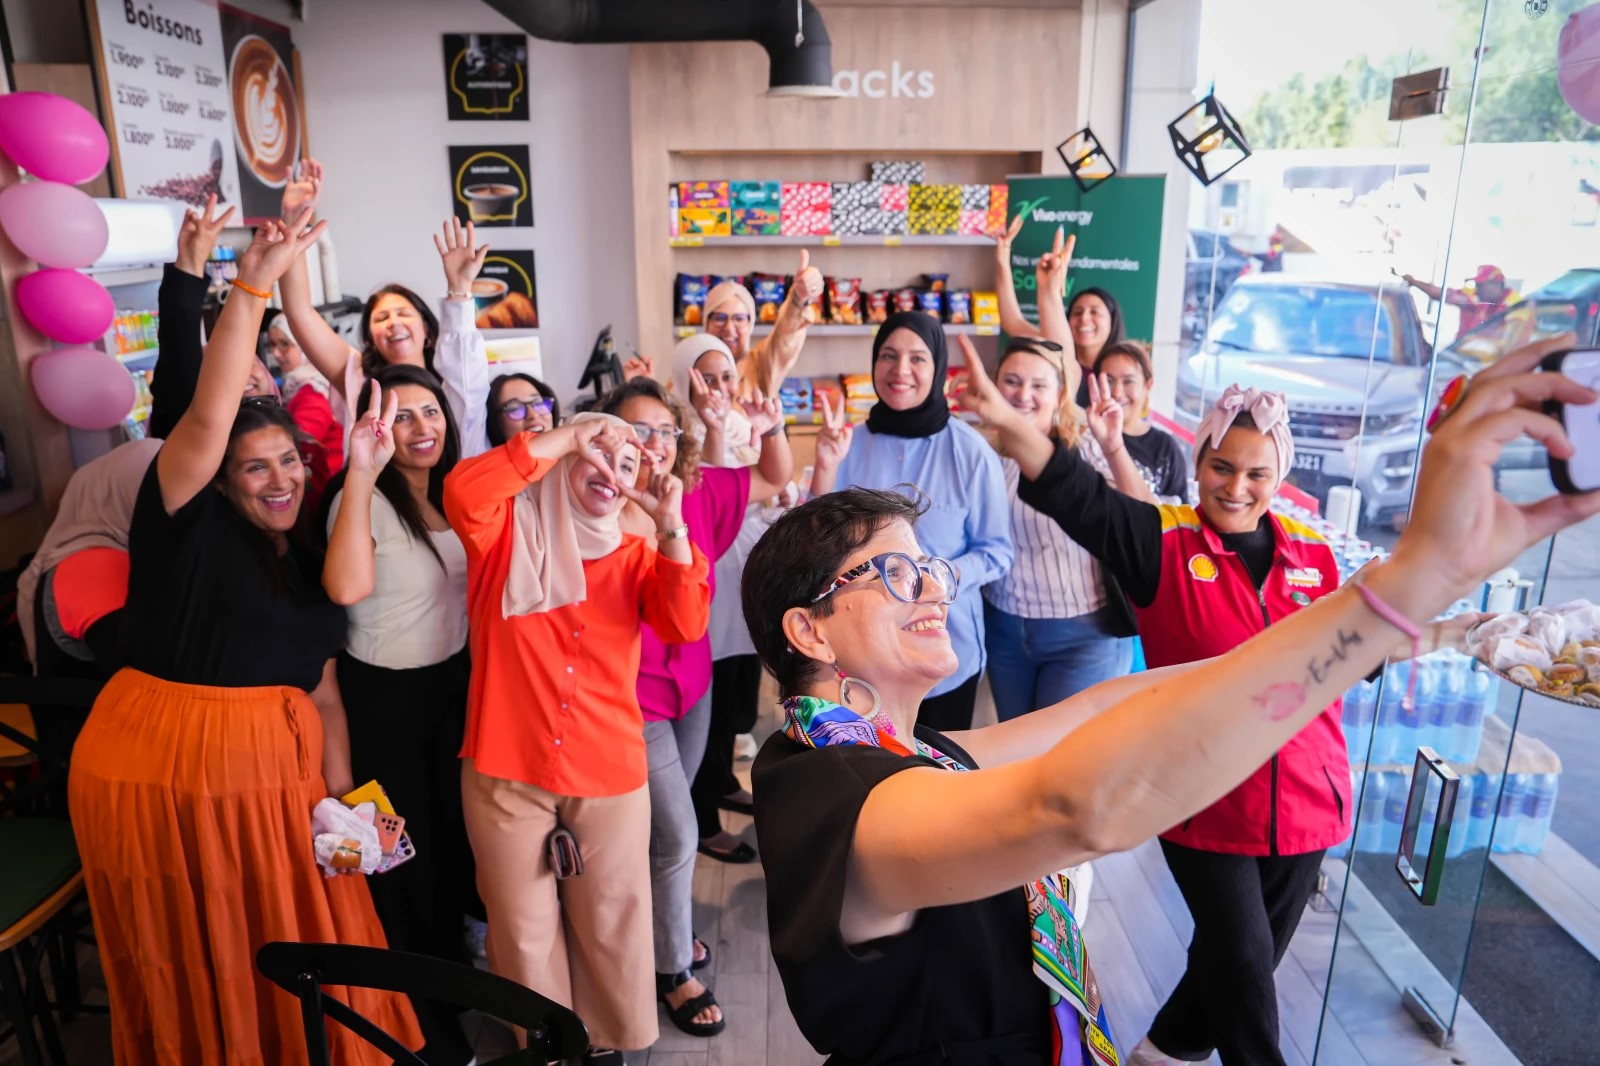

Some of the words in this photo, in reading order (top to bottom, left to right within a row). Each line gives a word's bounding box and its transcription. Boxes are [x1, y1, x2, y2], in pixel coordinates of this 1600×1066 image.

[123, 0, 203, 46] Boissons
[831, 60, 935, 98] acks
[1068, 256, 1140, 271] ondamentales
